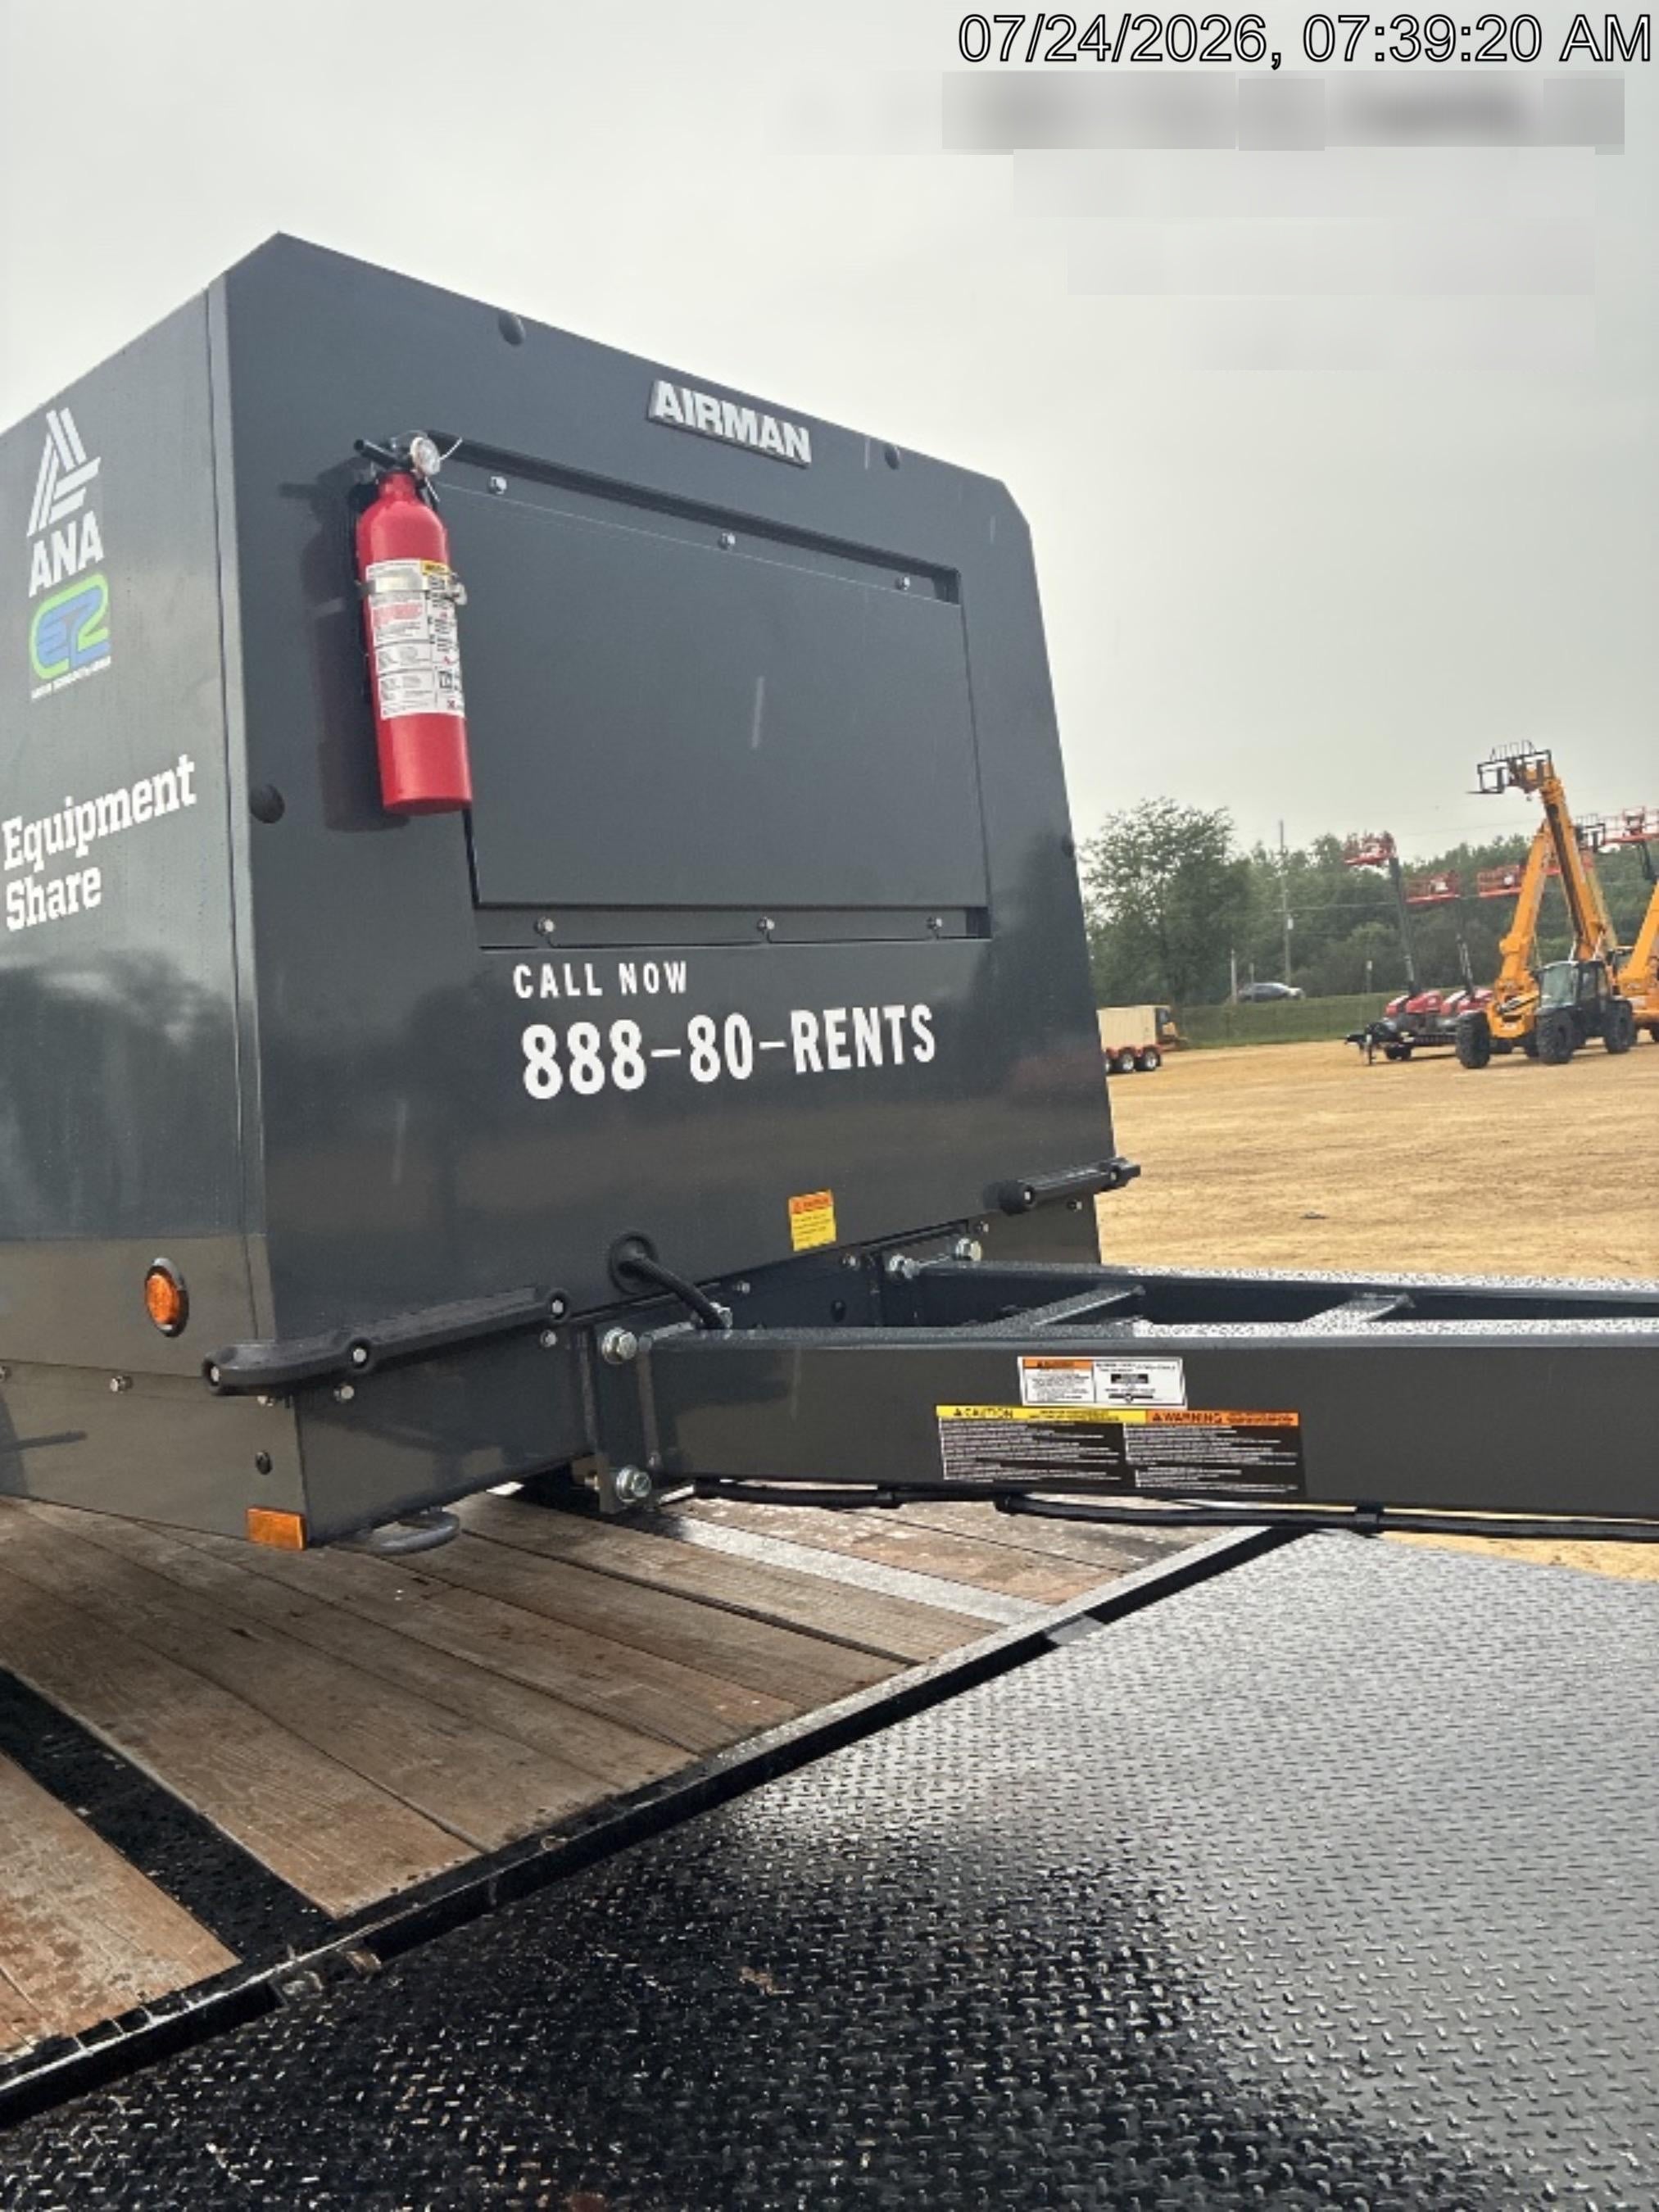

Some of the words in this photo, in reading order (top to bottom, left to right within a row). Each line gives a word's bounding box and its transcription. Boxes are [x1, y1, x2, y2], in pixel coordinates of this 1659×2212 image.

[649, 380, 811, 463] AIRMAN
[29, 510, 105, 598] ANA
[2, 755, 197, 873] Equipment
[5, 866, 102, 932] Share
[512, 962, 603, 999] CALL
[618, 960, 688, 996] NOW
[520, 1003, 936, 1100] 888-80-RENTS
[1164, 1412, 1223, 1425] WARNING
